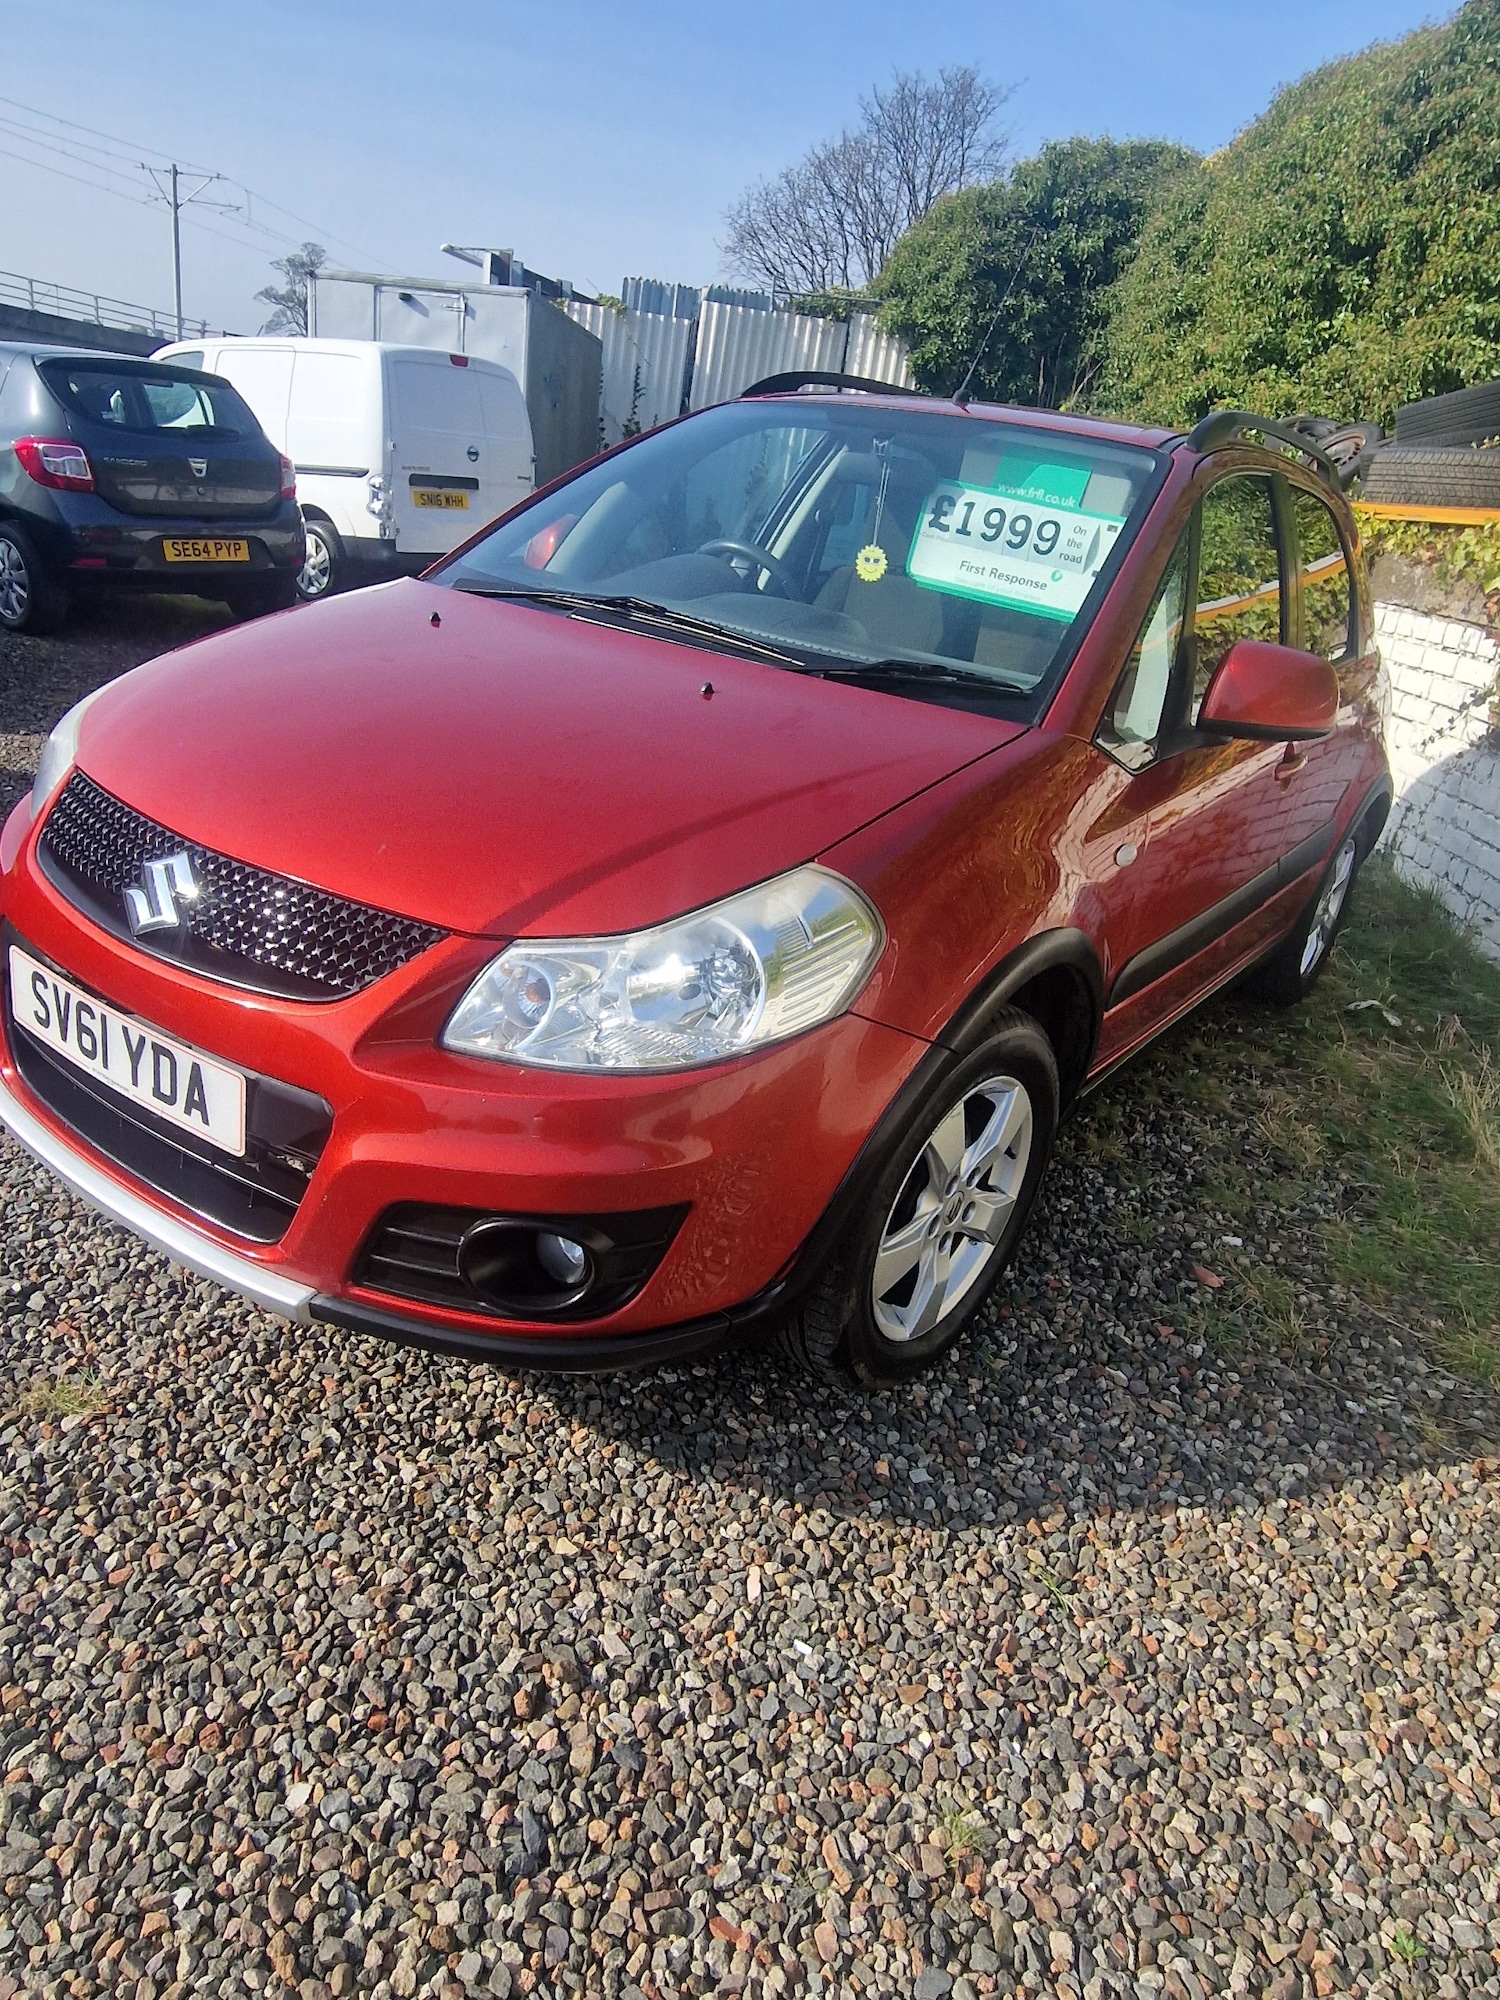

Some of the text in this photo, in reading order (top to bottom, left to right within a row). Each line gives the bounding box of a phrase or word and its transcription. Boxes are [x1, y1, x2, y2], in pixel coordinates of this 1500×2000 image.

[420, 493, 464, 508] SN16 WHH
[928, 494, 1062, 556] £1999
[1073, 525, 1087, 537] On
[171, 541, 242, 558] SE64 PYP
[1066, 537, 1083, 549] the
[1059, 551, 1083, 564] road
[959, 560, 986, 576] First
[989, 567, 1048, 591] Response
[31, 970, 210, 1127] SV61 YDA
